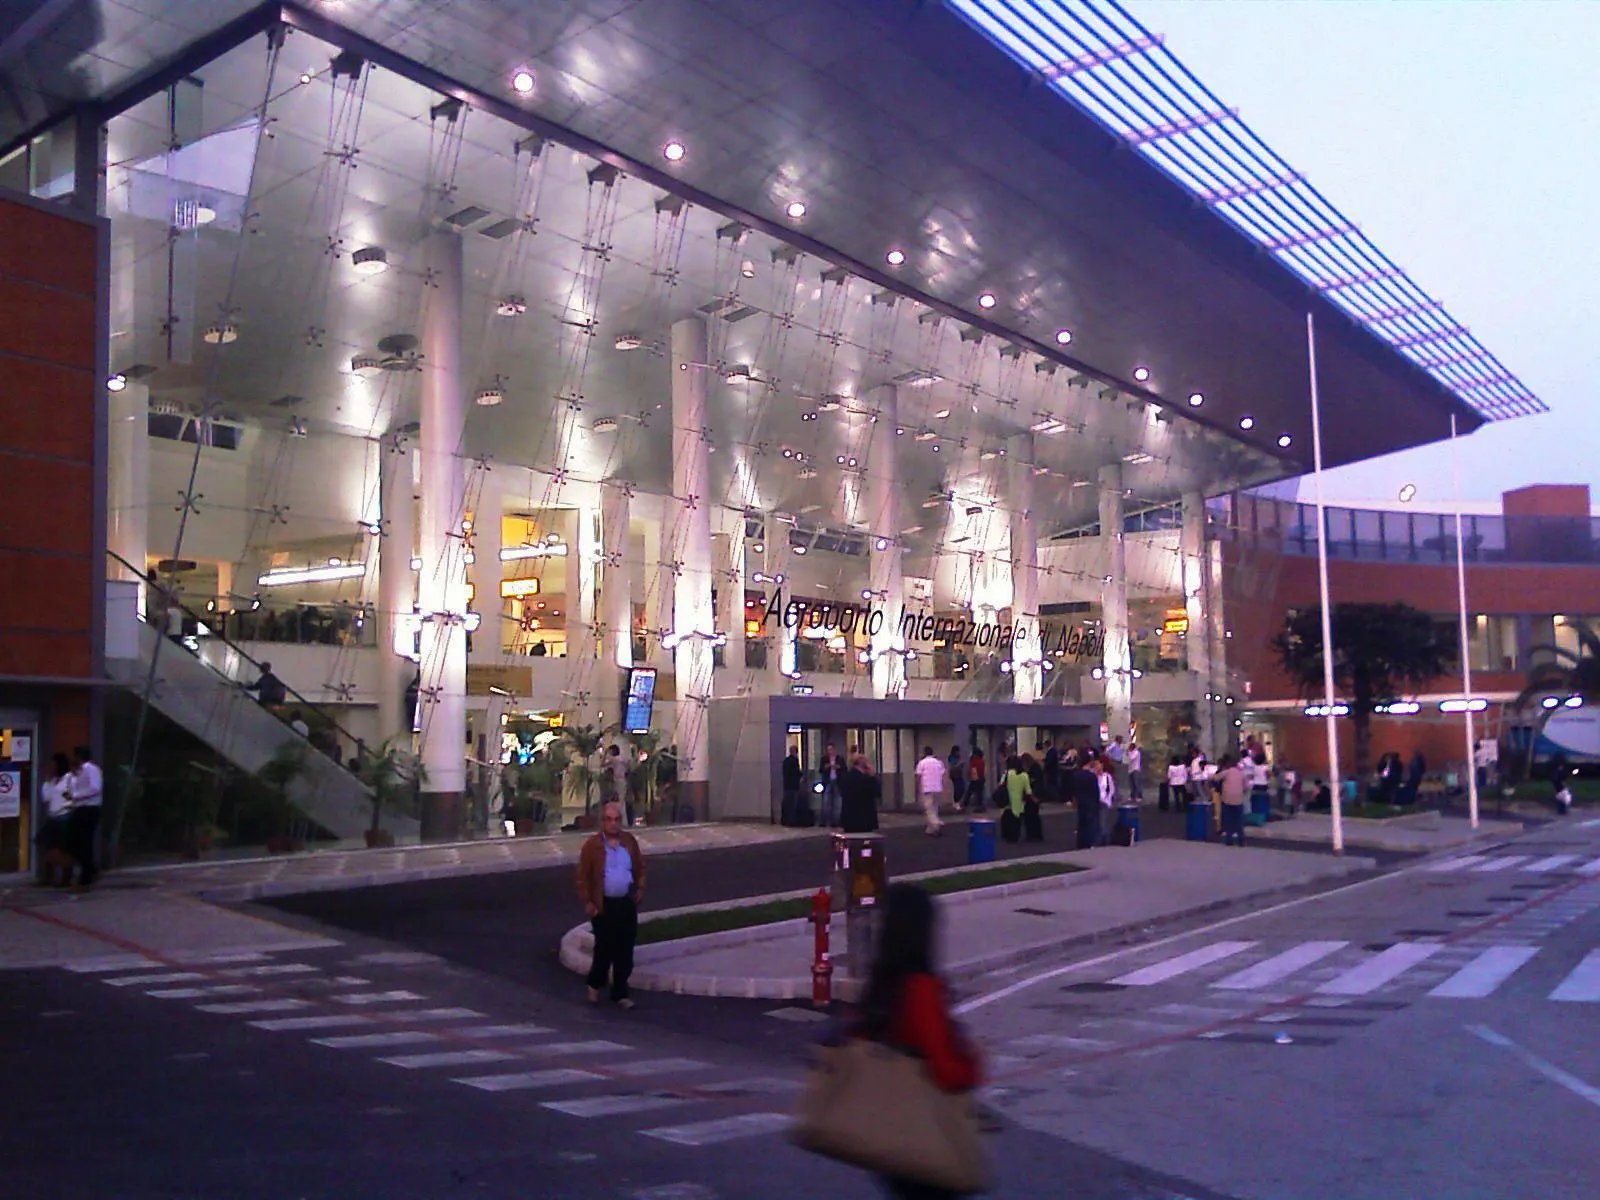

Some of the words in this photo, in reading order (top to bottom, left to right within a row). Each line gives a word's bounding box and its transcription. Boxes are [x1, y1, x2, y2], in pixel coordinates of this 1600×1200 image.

[762, 587, 884, 637] Aeroporto
[897, 603, 1027, 650] Internazionale
[1057, 624, 1107, 663] Napoli
